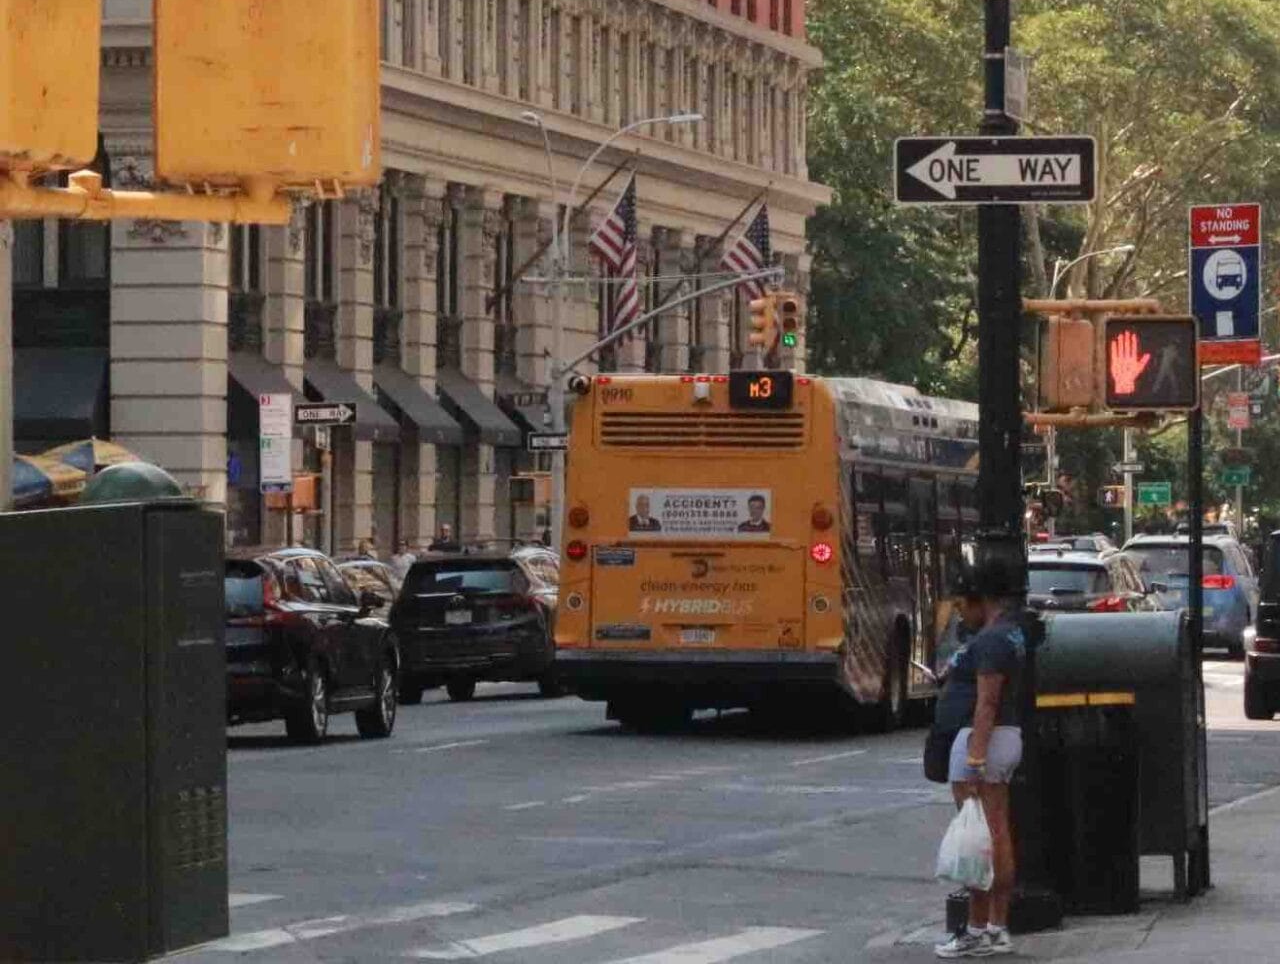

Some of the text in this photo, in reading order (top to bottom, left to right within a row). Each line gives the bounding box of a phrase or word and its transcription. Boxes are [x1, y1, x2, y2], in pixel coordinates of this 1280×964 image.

[928, 157, 1072, 183] ONE WAY
[1216, 208, 1233, 220] NO
[1200, 220, 1250, 233] STANDING
[750, 377, 772, 397] M3
[302, 410, 319, 418] ONE
[663, 499, 738, 509] ACCIDENT?
